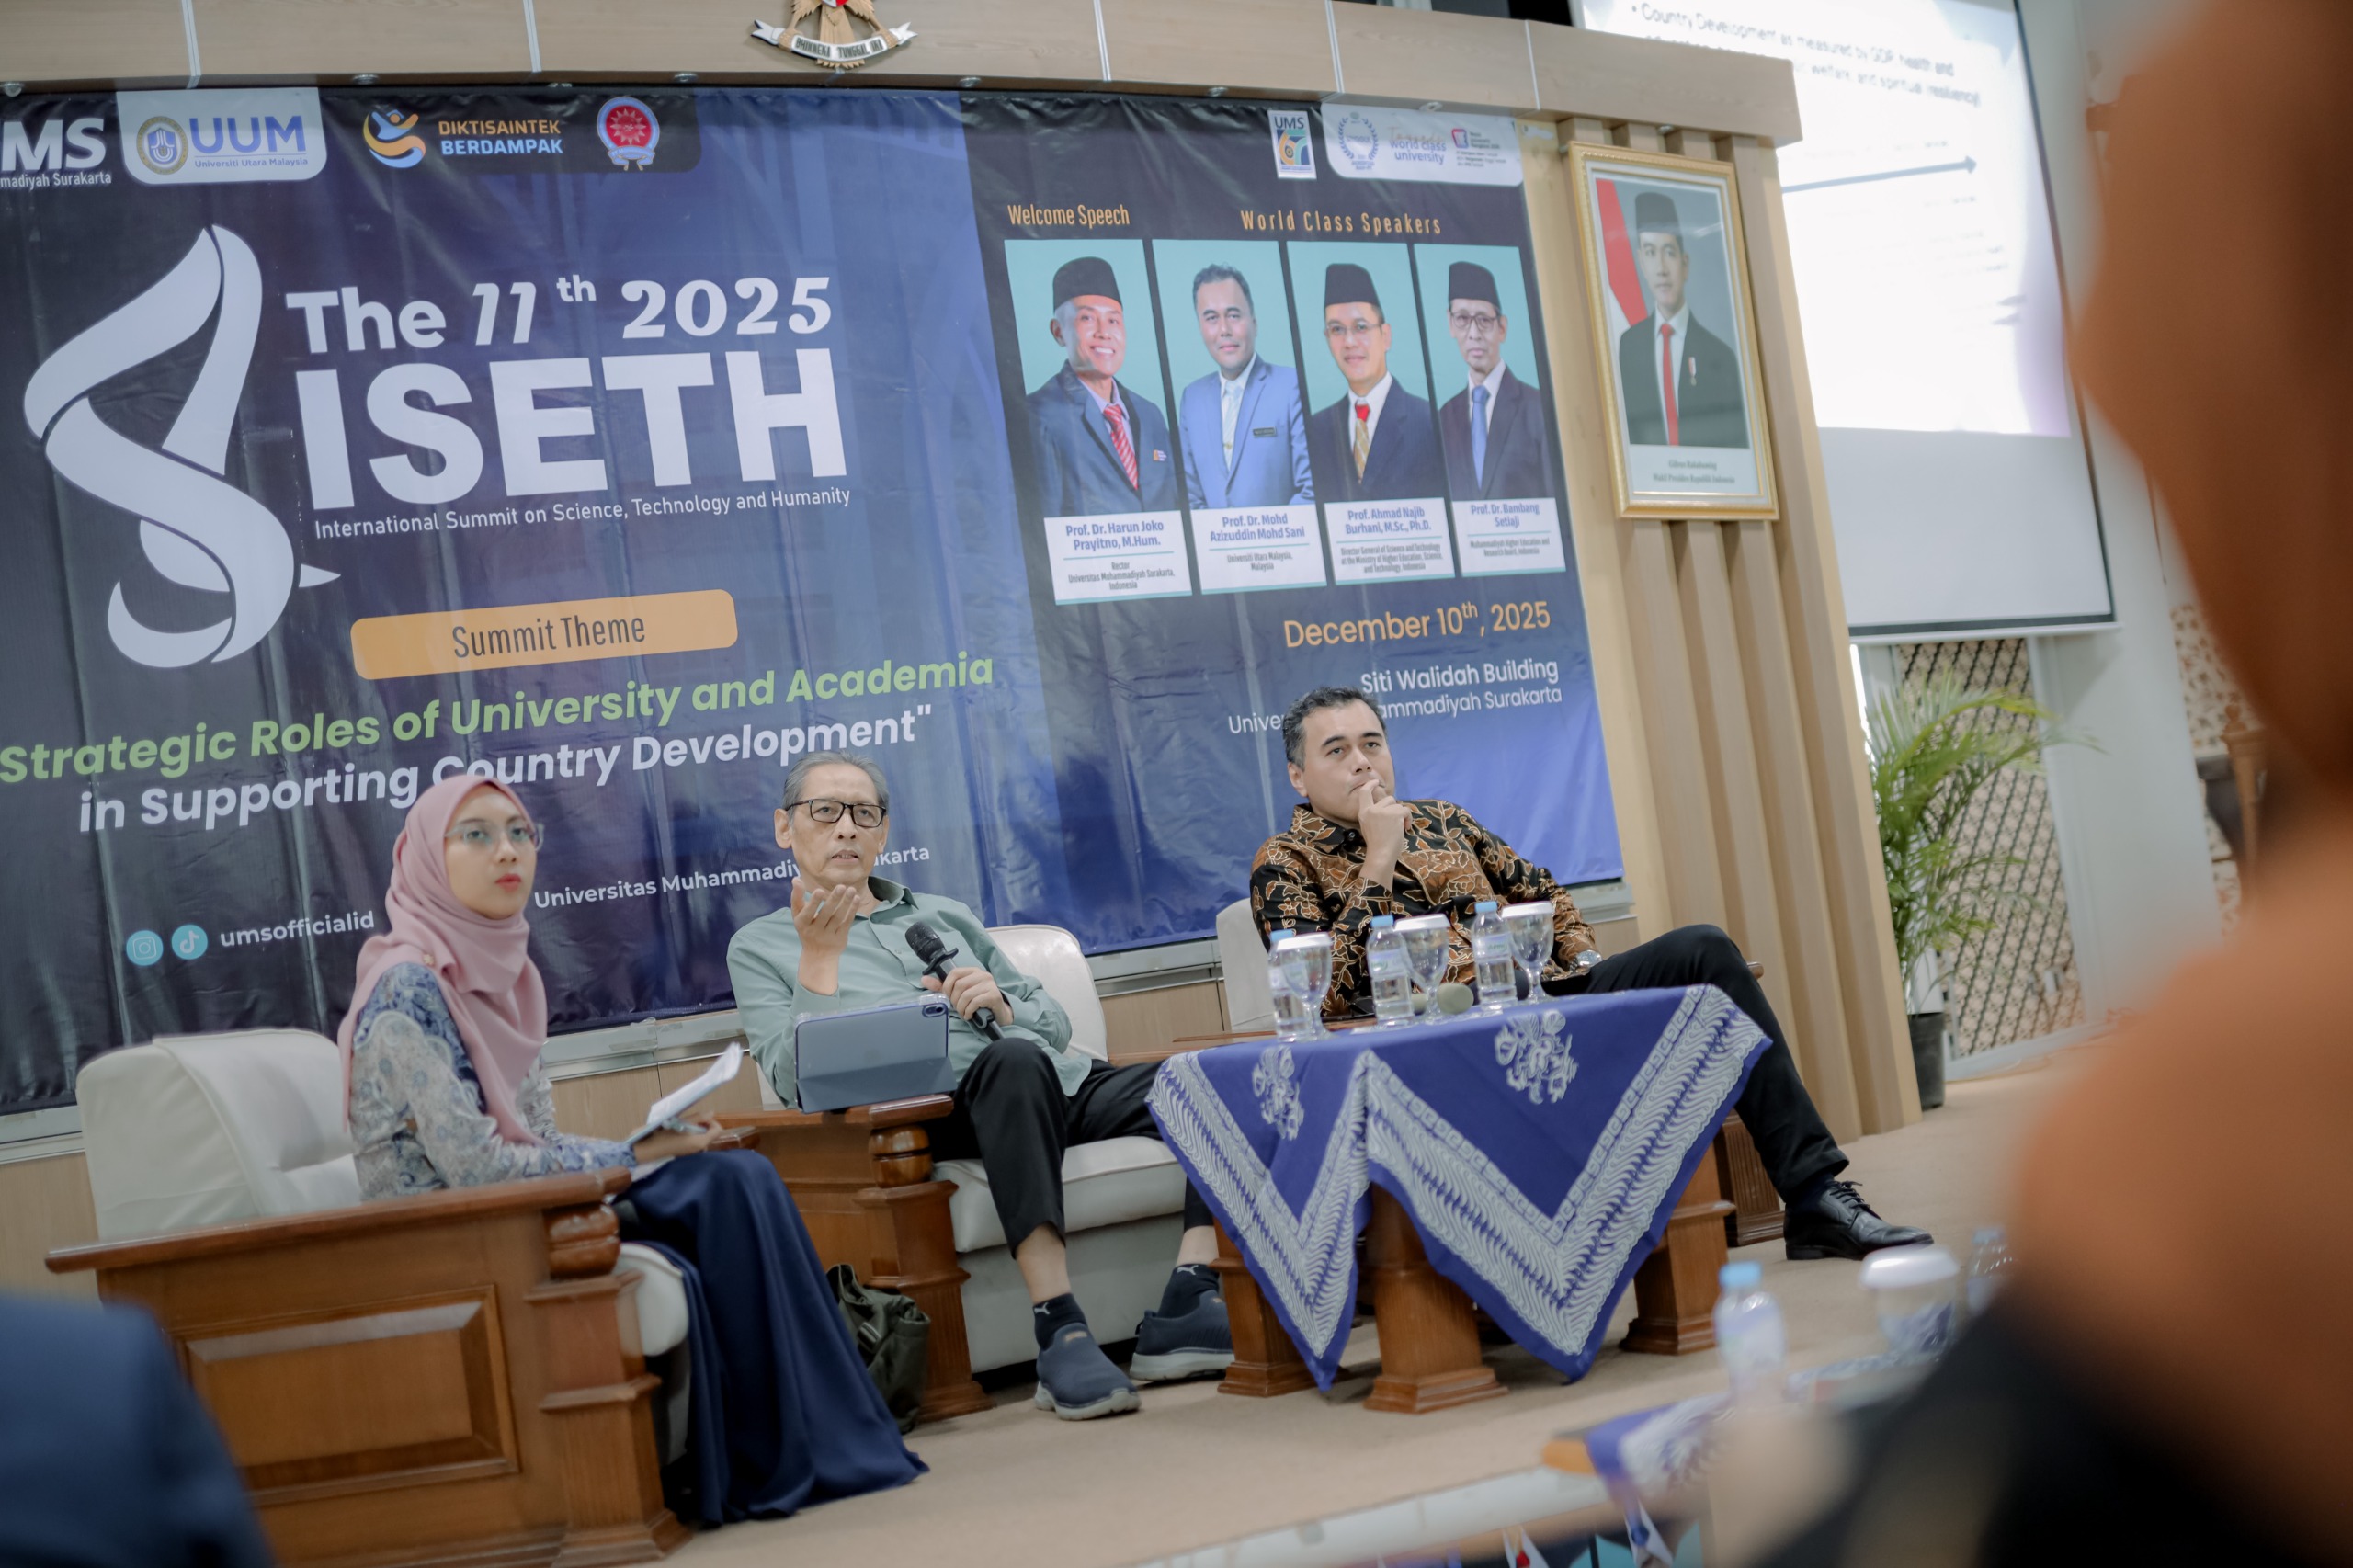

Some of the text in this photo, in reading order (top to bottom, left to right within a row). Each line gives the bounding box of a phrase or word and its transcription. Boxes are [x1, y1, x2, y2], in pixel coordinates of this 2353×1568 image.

[438, 119, 561, 136] DIKTISAINTEK
[1274, 116, 1304, 130] UMS
[189, 116, 306, 153] UUM
[441, 138, 563, 155] BERDAMPAK
[195, 160, 239, 168] Universiti
[269, 157, 308, 166] Malaysia
[1394, 149, 1444, 165] university
[52, 172, 112, 187] Surakarta
[1008, 204, 1130, 227] Welcome Speech
[1241, 210, 1441, 236] World Class Speakers
[286, 286, 446, 354] The
[621, 277, 832, 338] 2025
[295, 348, 847, 511] ISETH
[314, 487, 850, 539] International Summit on Science, Technology and Humanity
[1347, 506, 1425, 520] Prof. Ahmad Najib
[1471, 502, 1540, 515] Prof. Dr. Bambang
[1066, 520, 1164, 536] Prof. Dr. Harun Joko
[1222, 513, 1288, 528] Prof. Dr. Mohd
[1346, 522, 1383, 534] Burhani,
[1410, 520, 1431, 530] Ph.D.
[1495, 516, 1519, 528] Setiaji
[1074, 536, 1161, 551] Prayitno, M.Hum.
[1211, 526, 1305, 541] Azizuddin Mohd Sani
[1284, 611, 1429, 648] December
[1491, 601, 1551, 631] 2025
[452, 614, 645, 658] Summit Theme
[1360, 658, 1558, 695] Siti Walidah Building
[0, 650, 993, 782] Strategic Roles of University and Academia
[1228, 713, 1284, 733] Unive
[1484, 687, 1563, 710] Surakarta
[79, 790, 125, 832] in
[141, 762, 418, 831] Supporting
[432, 744, 621, 787] Country
[534, 876, 656, 909] Universitas
[221, 911, 375, 947] umsofficialid
